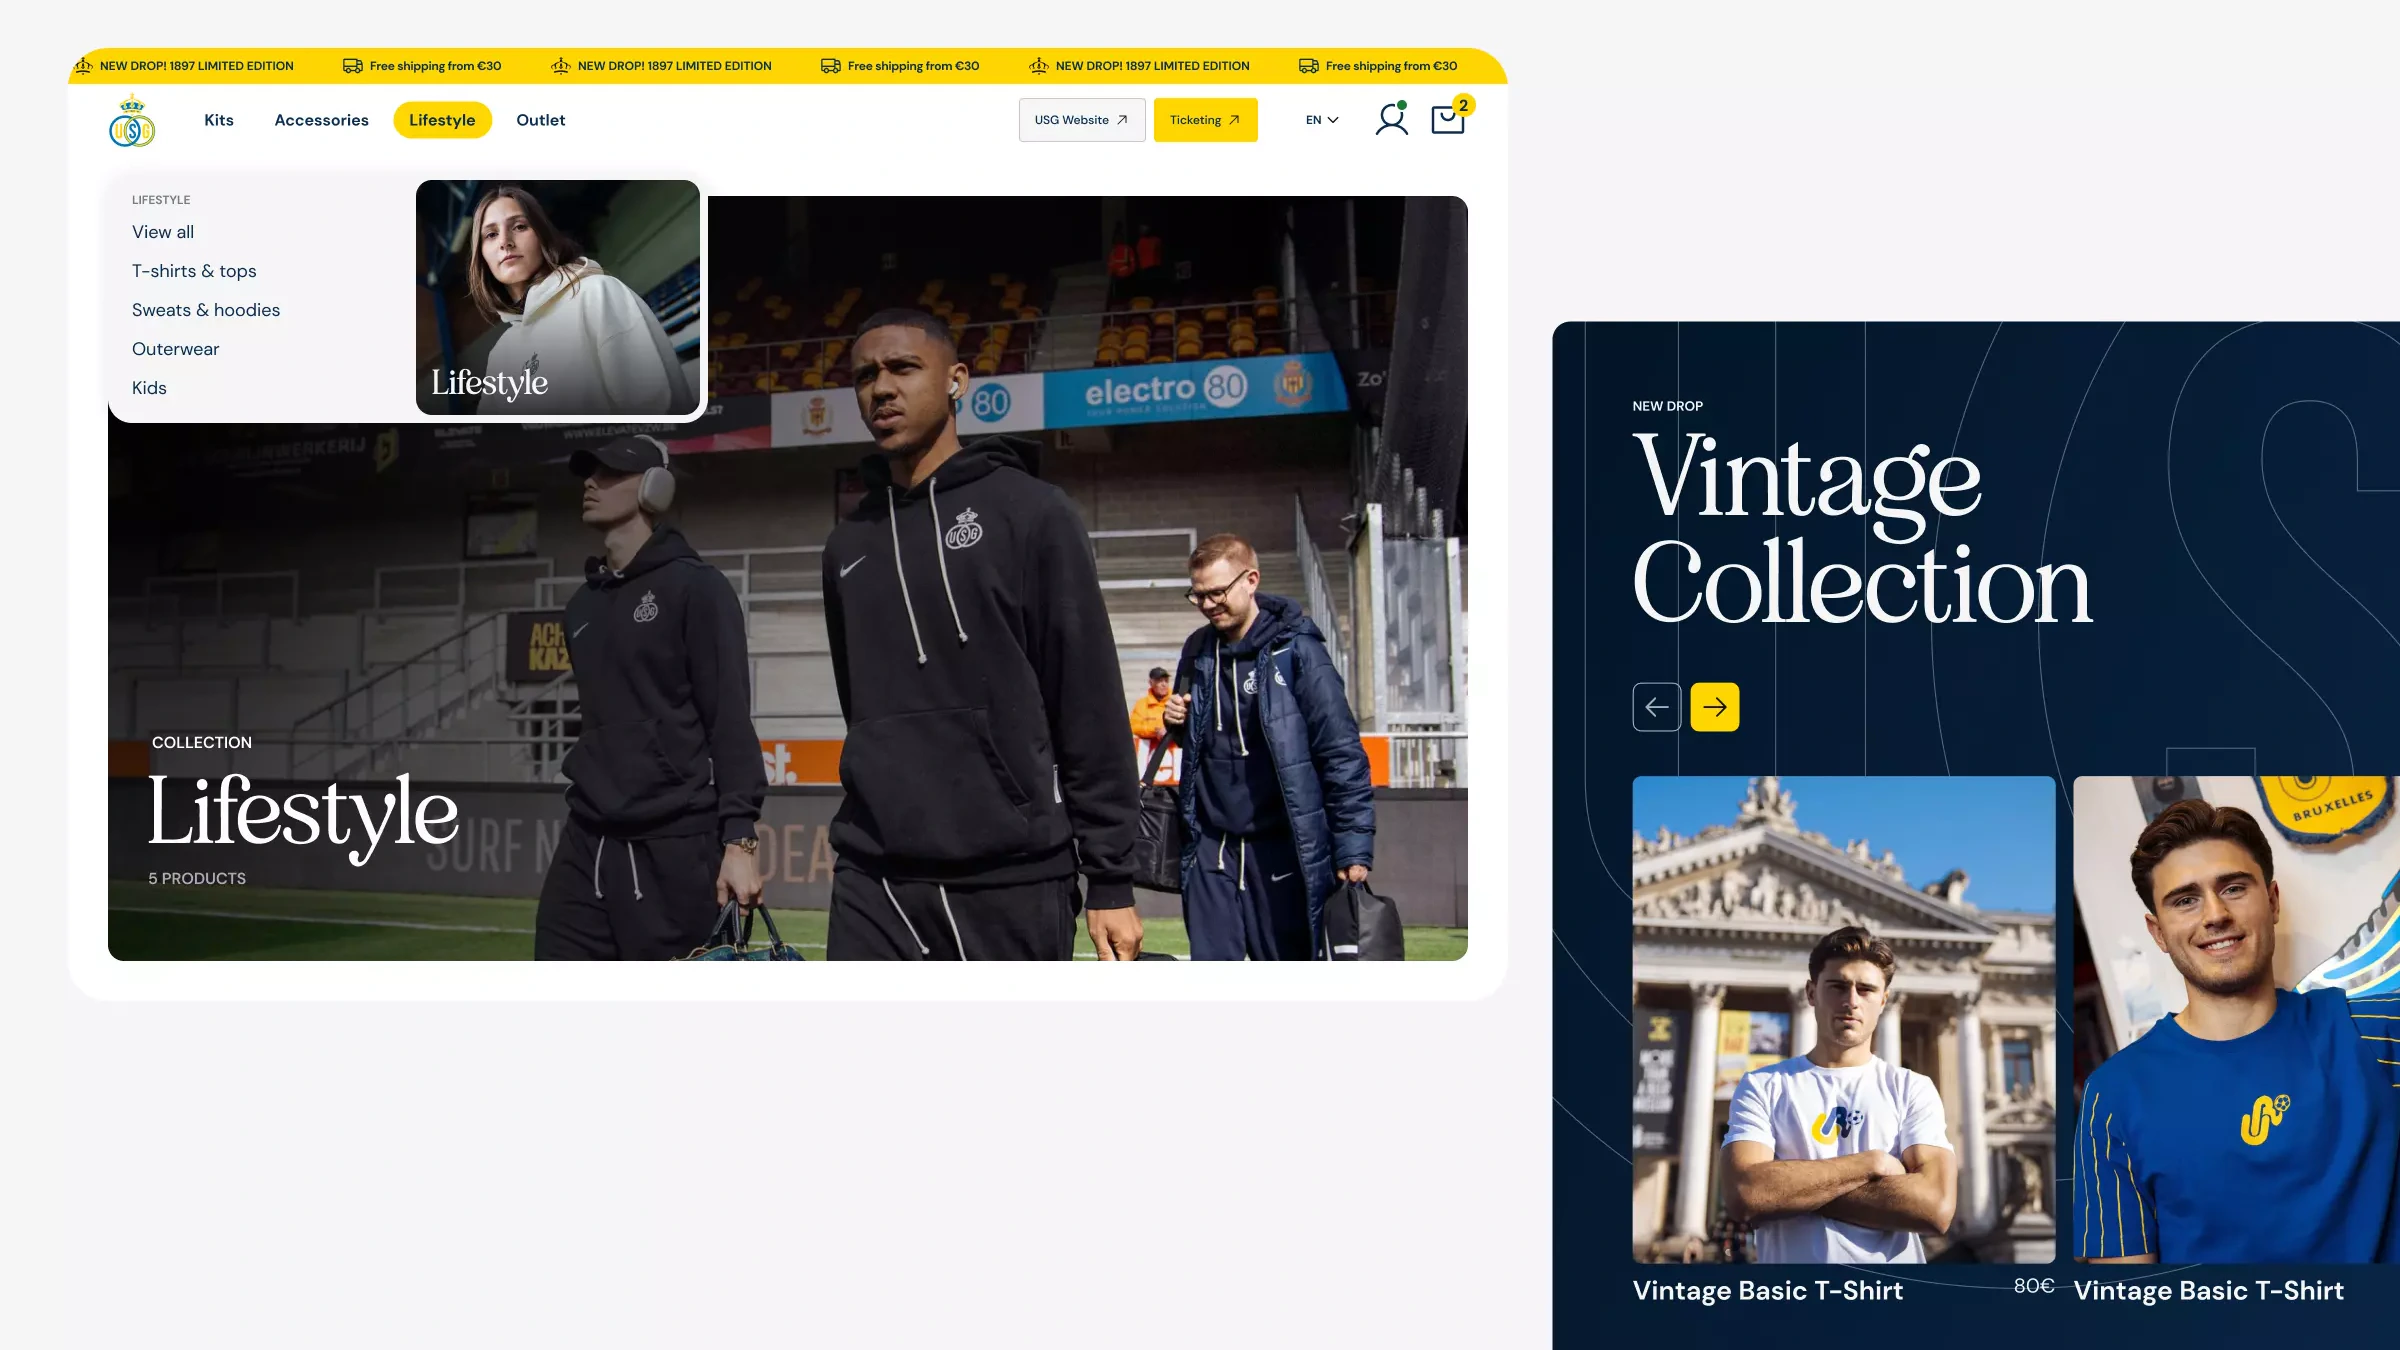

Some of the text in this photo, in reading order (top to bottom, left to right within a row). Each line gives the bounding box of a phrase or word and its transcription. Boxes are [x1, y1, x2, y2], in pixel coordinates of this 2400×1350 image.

[99, 60, 295, 71] NEW DROP! 1897 LIMITED EDITION
[369, 60, 503, 74] Free shipping from €30
[577, 60, 773, 71] NEW DROP! 1897 LIMITED EDITION
[847, 60, 981, 74] Free shipping from €30
[1055, 60, 1251, 71] NEW DROP! 1897 LIMITED EDITION
[1325, 60, 1459, 74] Free shipping from €30
[1459, 99, 1468, 111] 2
[204, 113, 234, 127] Kits
[274, 113, 369, 127] Accessories
[409, 113, 476, 130] Lifestyle
[516, 113, 566, 127] Outlet
[1035, 114, 1110, 125] USG Website
[1170, 114, 1222, 128] Ticketing
[1306, 114, 1322, 125] EN
[132, 195, 191, 205] LIFESTYLE
[132, 224, 194, 239] View all
[132, 263, 257, 282] T-shirts & tops
[132, 302, 281, 317] Sweats & hoodies
[132, 341, 220, 356] Outerwear
[132, 380, 167, 395] Kids
[432, 368, 549, 403] Lifestyle
[1086, 373, 1244, 405] electro 80
[974, 389, 1008, 416] 80
[1632, 400, 1704, 412] NEW DROP
[1631, 432, 1982, 545] Vintage
[1634, 536, 2094, 624] Collection
[152, 736, 252, 749] COLLECTION
[2292, 790, 2373, 821] BRUXELLES
[148, 772, 459, 867] Lifestyle
[148, 872, 246, 885] 5 PRODUCTS
[2013, 1277, 2056, 1294] 80€
[1632, 1279, 1905, 1307] Vintage Basic T-Shirt
[2073, 1279, 2345, 1307] Vintage Basic T-Shirt
